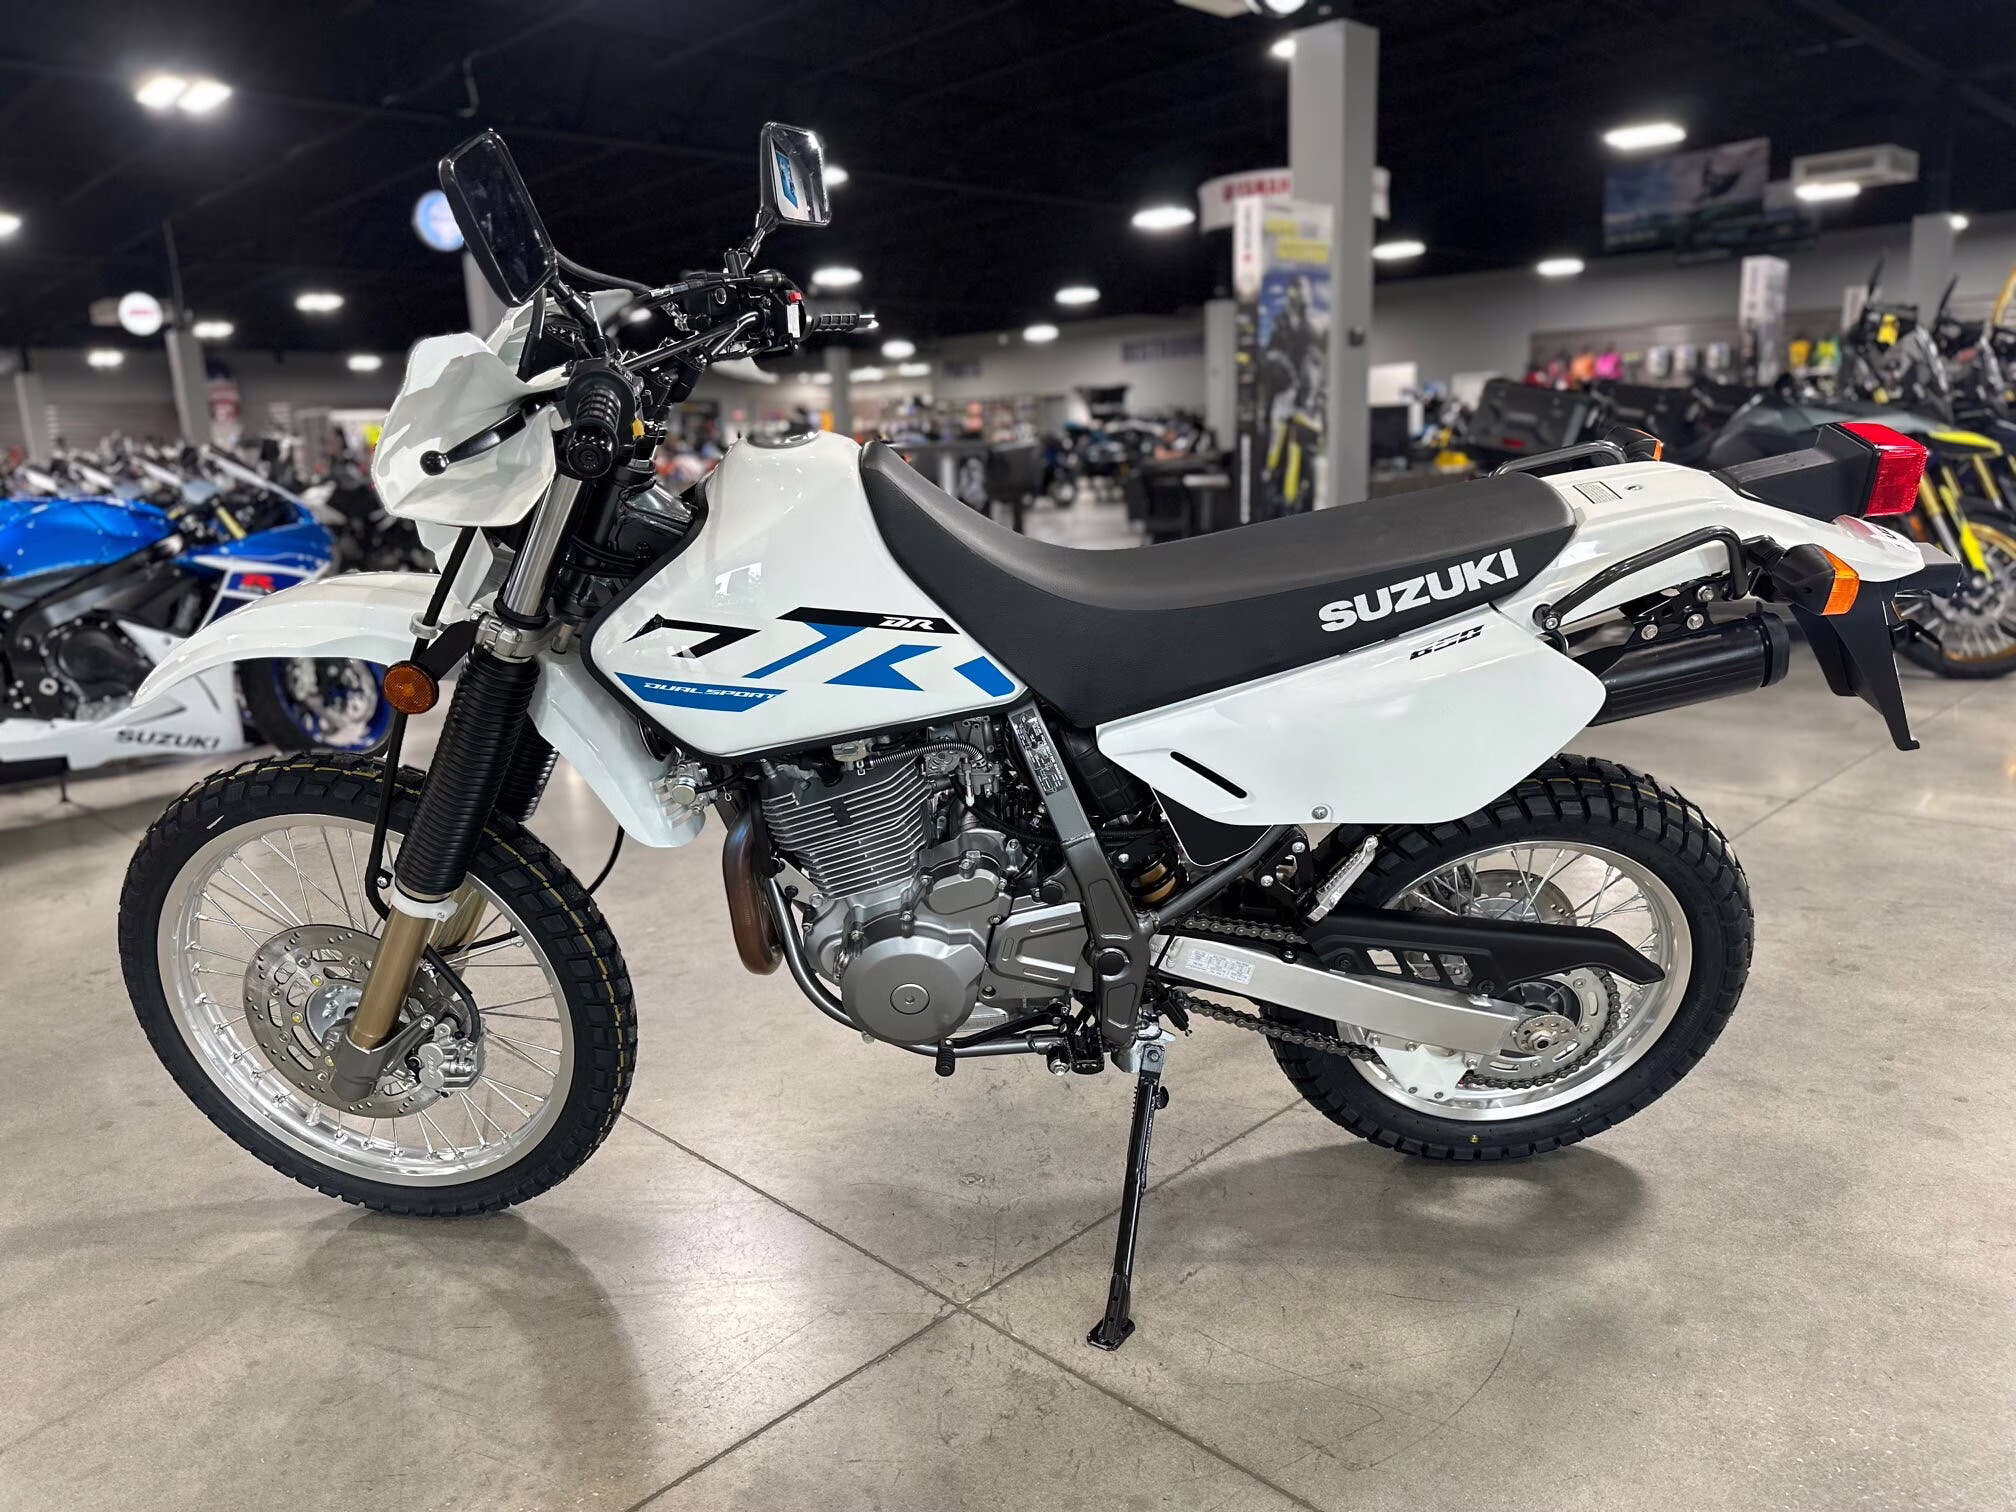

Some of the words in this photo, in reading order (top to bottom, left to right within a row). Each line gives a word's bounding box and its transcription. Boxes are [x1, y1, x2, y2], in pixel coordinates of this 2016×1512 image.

[1318, 548, 1519, 632] SUZUKI
[879, 616, 934, 631] DR
[644, 682, 703, 695] DUAL
[706, 688, 777, 700] SPORT
[116, 729, 220, 750] SUZUKI
